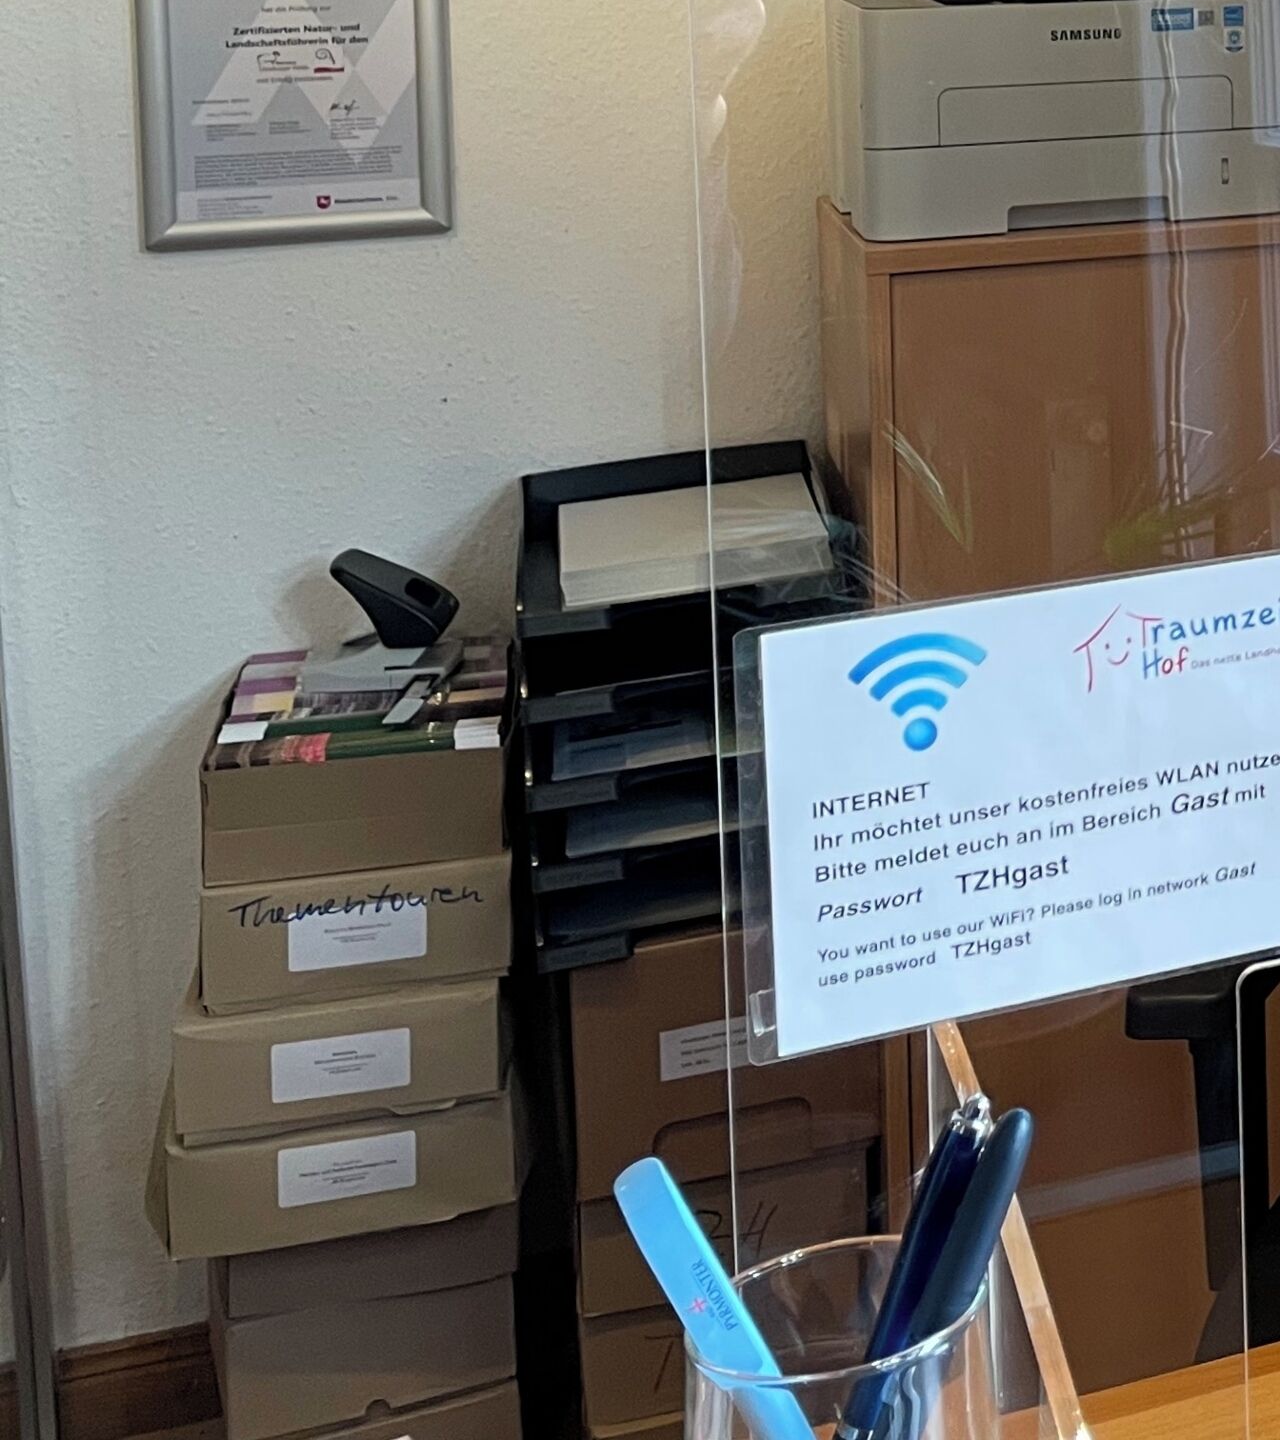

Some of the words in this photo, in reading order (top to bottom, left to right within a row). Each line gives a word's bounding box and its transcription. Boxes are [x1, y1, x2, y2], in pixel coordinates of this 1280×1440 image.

[233, 26, 301, 36] Zertifizierten
[1050, 28, 1122, 42] SAMSUNG
[1143, 645, 1190, 680] Hof
[812, 781, 931, 819] INTERNET
[813, 832, 844, 851] Ihr
[851, 813, 942, 845] möchtet
[950, 802, 1011, 826] unser
[1018, 776, 1149, 813] kostenfreies
[1156, 761, 1220, 787] WLAN
[815, 861, 867, 883] Bitte
[875, 844, 949, 872] meldet
[956, 832, 1009, 855] euch
[1016, 829, 1042, 845] an
[1049, 822, 1074, 839] im
[1082, 804, 1161, 832] Bereich
[1171, 787, 1230, 814] Gast
[1235, 784, 1266, 804] mit
[227, 885, 484, 928] Thementouren
[817, 887, 923, 923] Passwort
[955, 855, 1070, 895] TZHgast
[817, 948, 850, 962] You
[855, 937, 896, 955] want
[900, 933, 916, 946] to
[922, 927, 951, 942] use
[957, 920, 985, 935] our
[989, 909, 1035, 929] WiFi?
[1041, 898, 1093, 919] Please
[1098, 893, 1123, 908] log
[1128, 886, 1142, 900] in
[1147, 873, 1209, 898] network
[1215, 862, 1256, 883] Gast
[818, 970, 849, 987] use
[855, 951, 937, 983] password
[950, 930, 1033, 960] TZHgast
